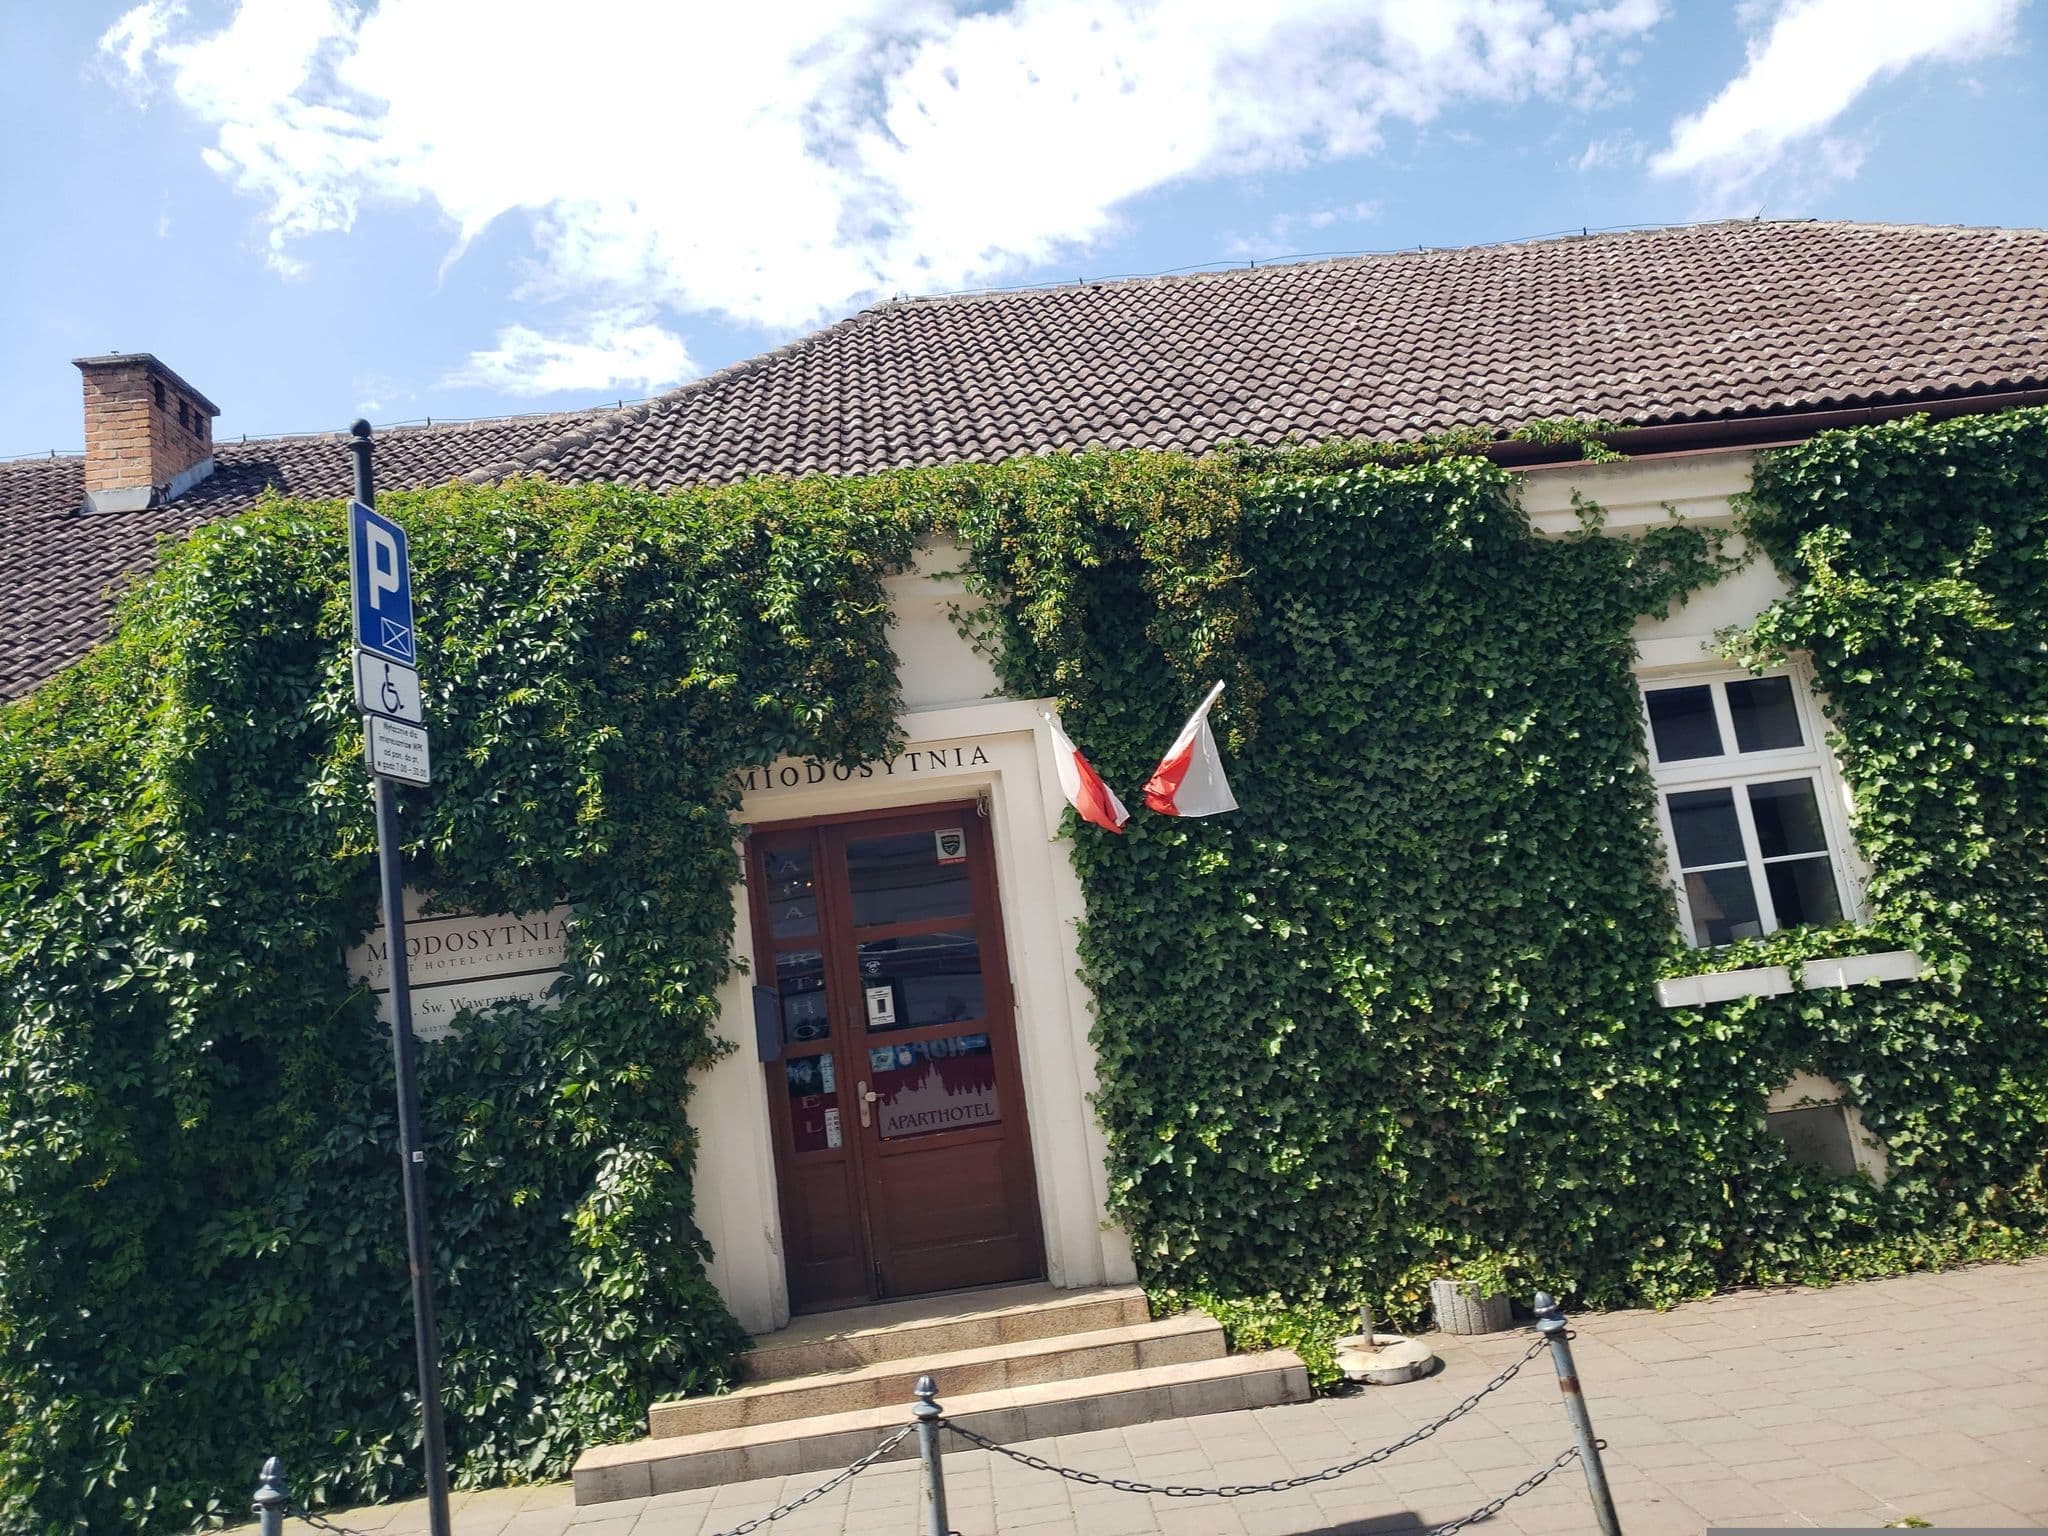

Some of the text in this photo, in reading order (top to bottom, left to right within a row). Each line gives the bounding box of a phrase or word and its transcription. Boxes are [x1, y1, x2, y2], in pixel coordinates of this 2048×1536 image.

[366, 519, 400, 610] P
[734, 745, 989, 791] MIODOSYTNIA
[366, 919, 571, 962] MODOSYTNIA
[367, 963, 415, 977] APT
[425, 955, 476, 970] HOTEL
[422, 997, 445, 1015] Św.
[888, 1103, 995, 1131] APARTHOTEL
